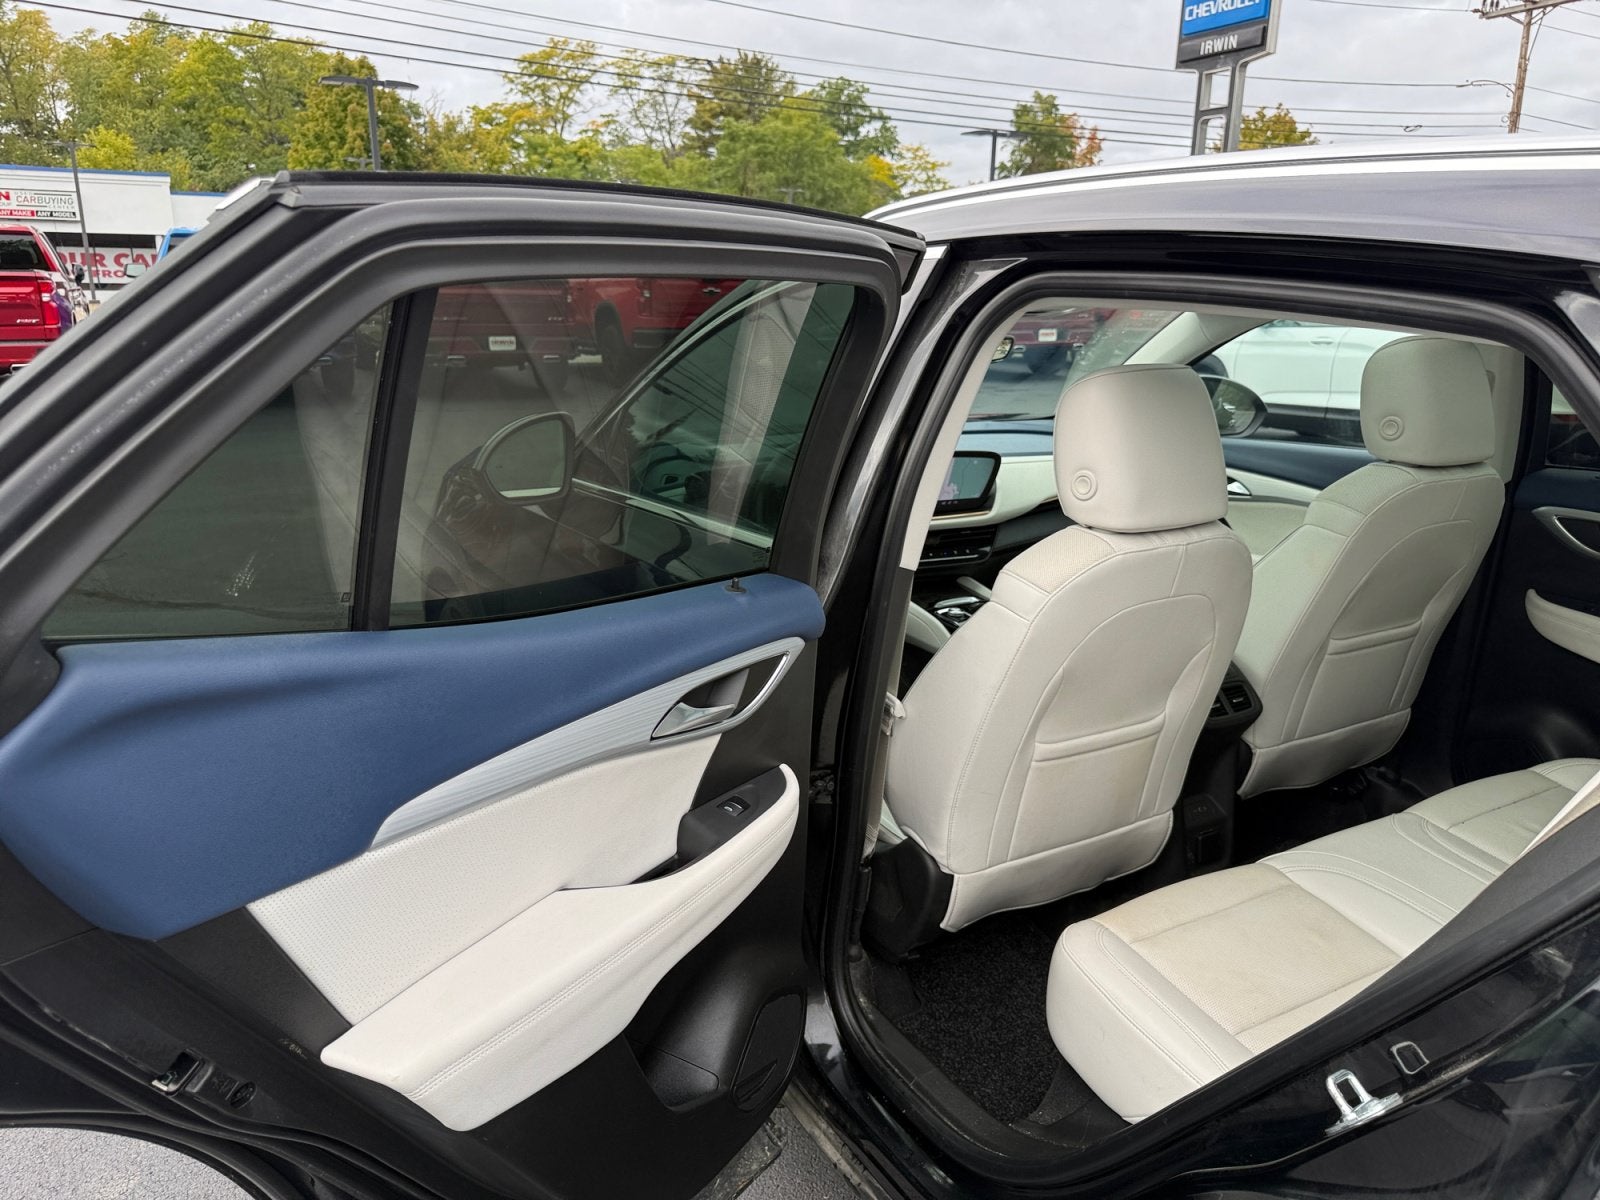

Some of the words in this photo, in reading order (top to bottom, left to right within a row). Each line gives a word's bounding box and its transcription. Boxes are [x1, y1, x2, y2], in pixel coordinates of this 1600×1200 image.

[1185, 0, 1259, 20] CHEVROL
[1200, 35, 1238, 55] IRWIN
[16, 195, 74, 205] CARBUYING
[92, 269, 125, 278] FRO
